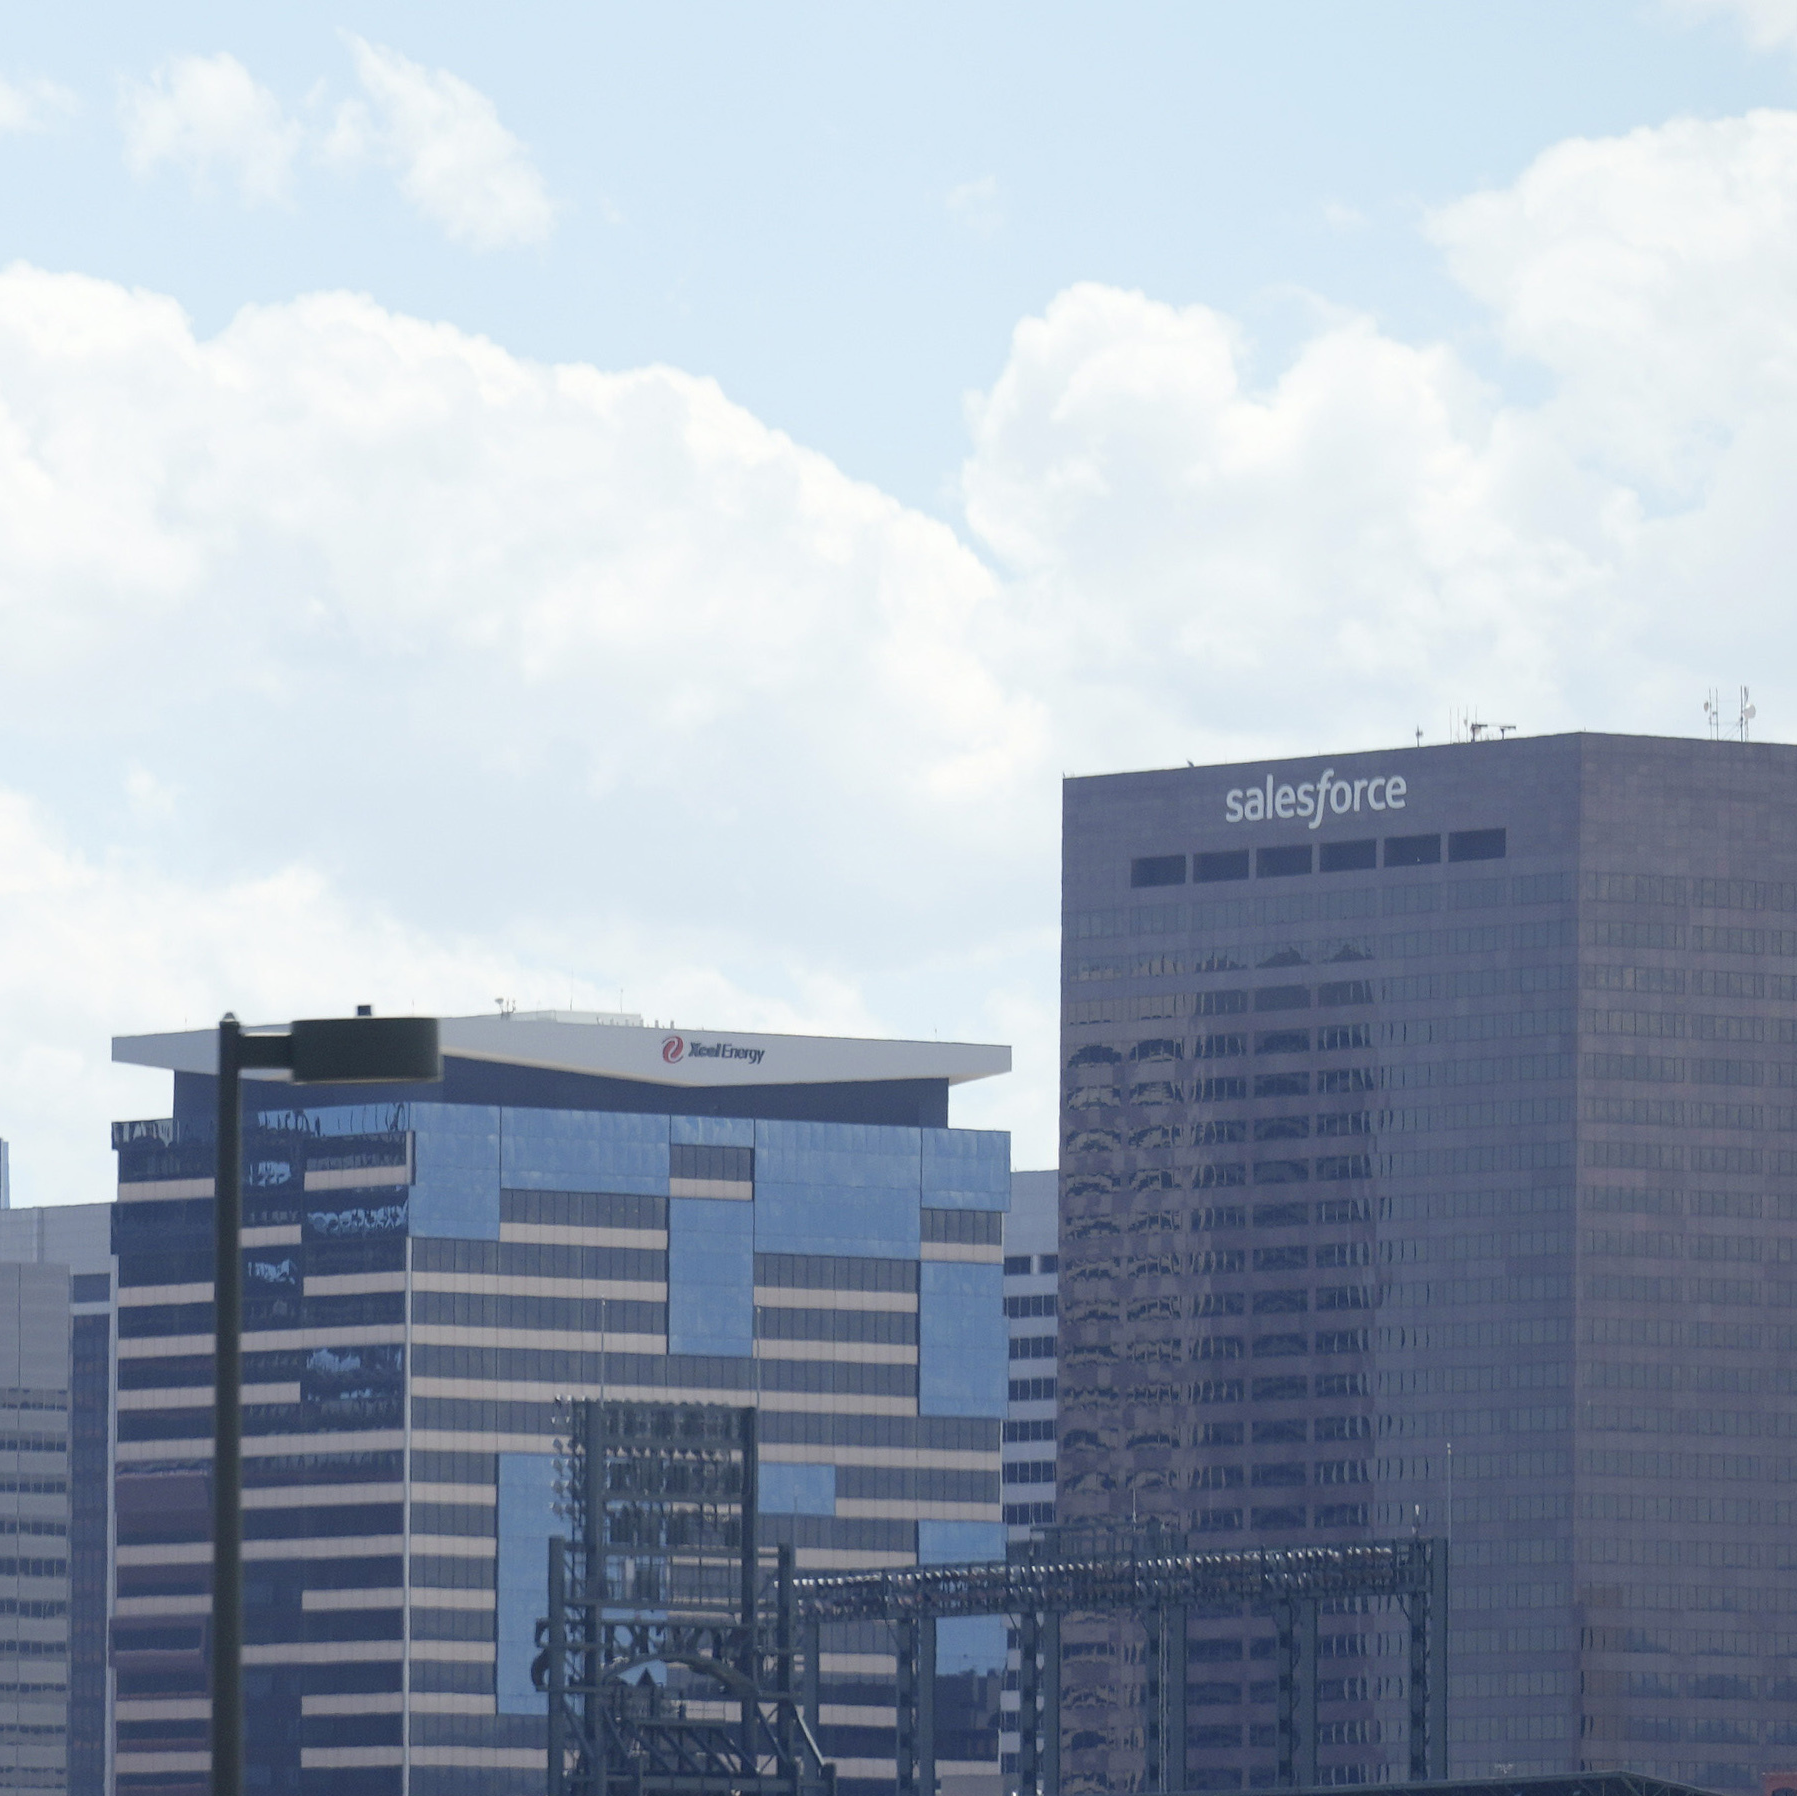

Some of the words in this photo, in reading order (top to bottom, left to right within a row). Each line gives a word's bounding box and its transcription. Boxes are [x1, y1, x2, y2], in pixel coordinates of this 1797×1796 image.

[1225, 768, 1408, 829] salesforce
[688, 1042, 722, 1058] Xcel
[722, 1043, 765, 1064] Energy
